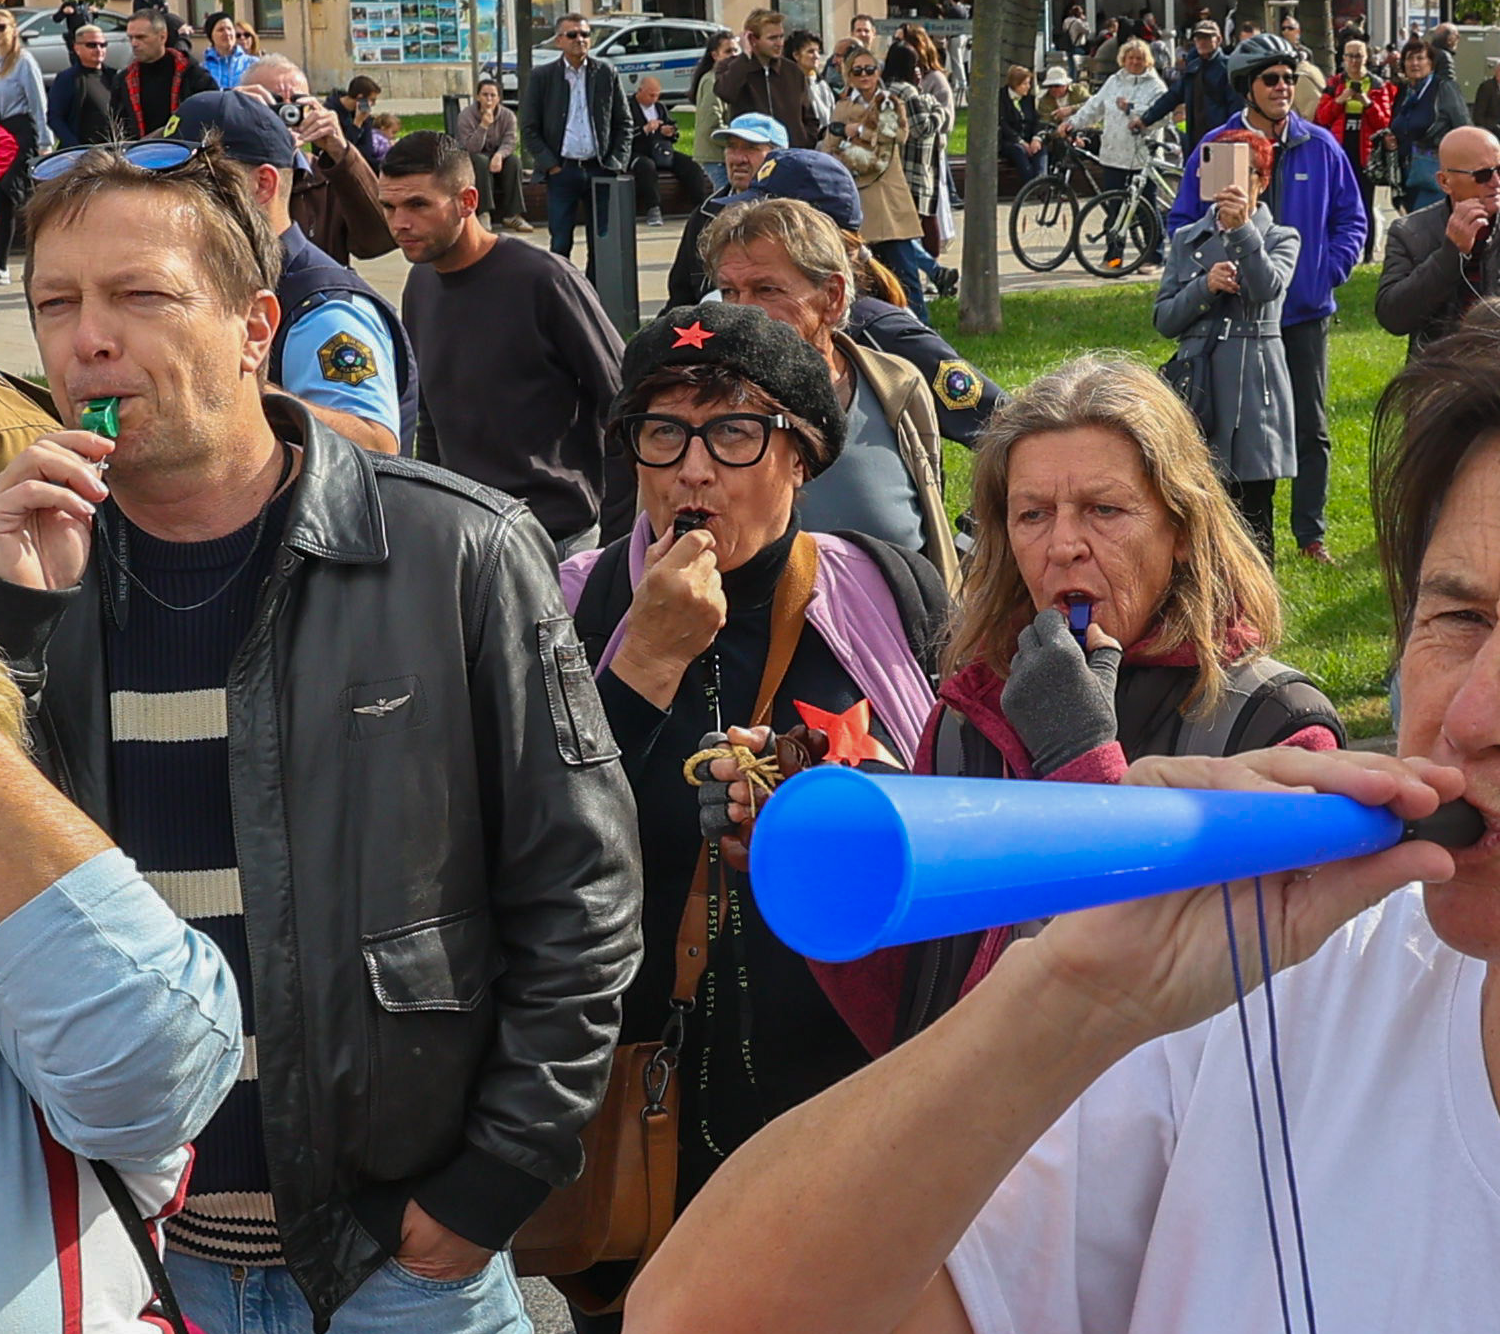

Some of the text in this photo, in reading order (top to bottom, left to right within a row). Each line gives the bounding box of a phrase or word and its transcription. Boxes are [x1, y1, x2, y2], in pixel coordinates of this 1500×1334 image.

[708, 894, 719, 941] KIPSTA
[728, 889, 741, 935] KIPSTA
[706, 971, 716, 1018] KIPSTA
